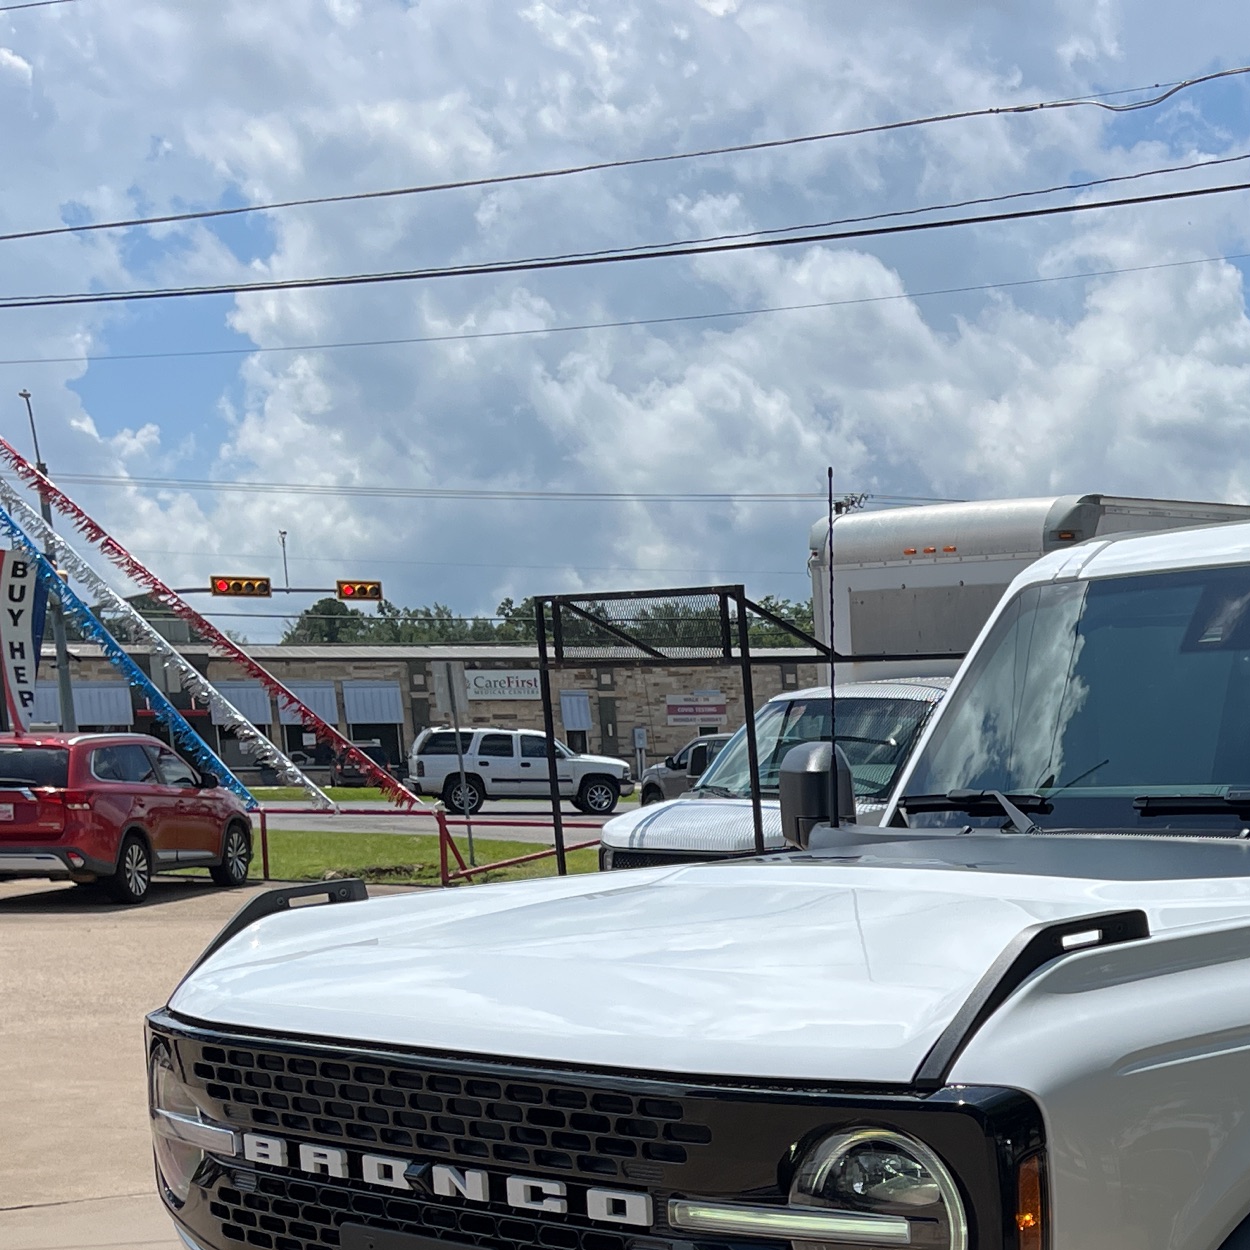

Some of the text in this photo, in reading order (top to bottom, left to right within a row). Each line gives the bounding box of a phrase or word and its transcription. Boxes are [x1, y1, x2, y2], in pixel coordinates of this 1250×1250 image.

[8, 561, 34, 717] BUY HER
[474, 676, 538, 689] CareFirst
[243, 1132, 654, 1227] BRONCO
